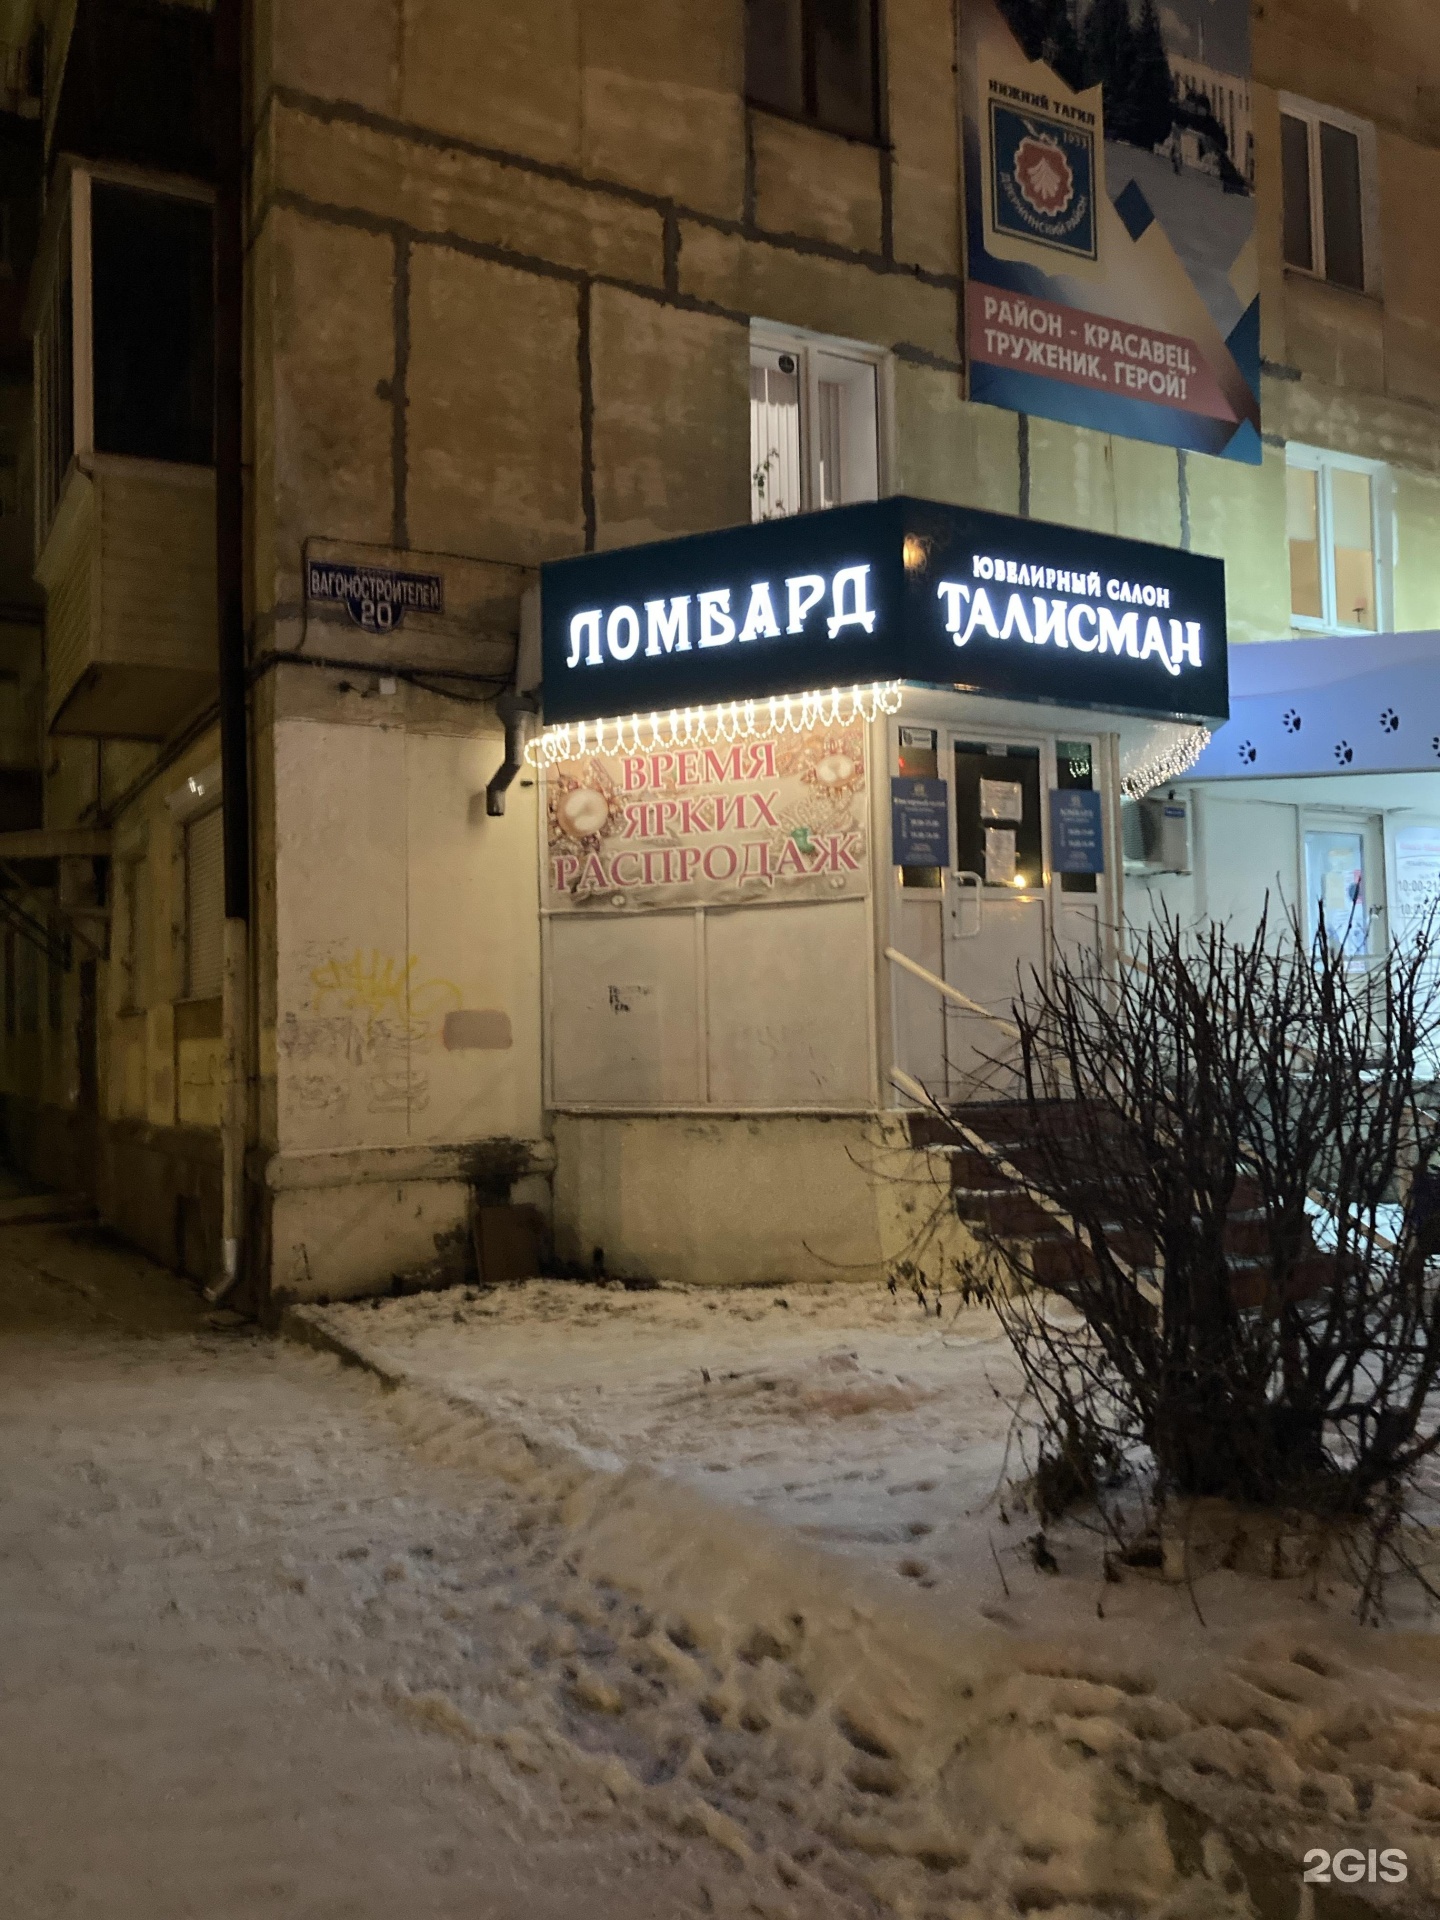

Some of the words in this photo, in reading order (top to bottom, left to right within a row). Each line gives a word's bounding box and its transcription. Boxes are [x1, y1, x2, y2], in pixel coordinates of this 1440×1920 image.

[988, 79, 1049, 111] НИЖНИЙ
[1053, 101, 1095, 126] ТАГИЛ
[984, 296, 1062, 338] РАЙОН
[1114, 361, 1187, 400] ГЕРОЙ!
[311, 569, 439, 607] ВАГОНОСТРОИТЕЛЕЙ
[973, 555, 1101, 598] ЮВЕЛИРНЫЙ
[1106, 578, 1170, 609] САЛОН
[361, 600, 392, 627] 20
[566, 564, 877, 669] ЛОМБАРД
[938, 581, 1203, 676] ТАЛИСМАН
[621, 740, 779, 793] ВРЕМЯ
[621, 790, 780, 841] ЯРКИХ
[553, 834, 861, 892] РАСПРОДАЖ
